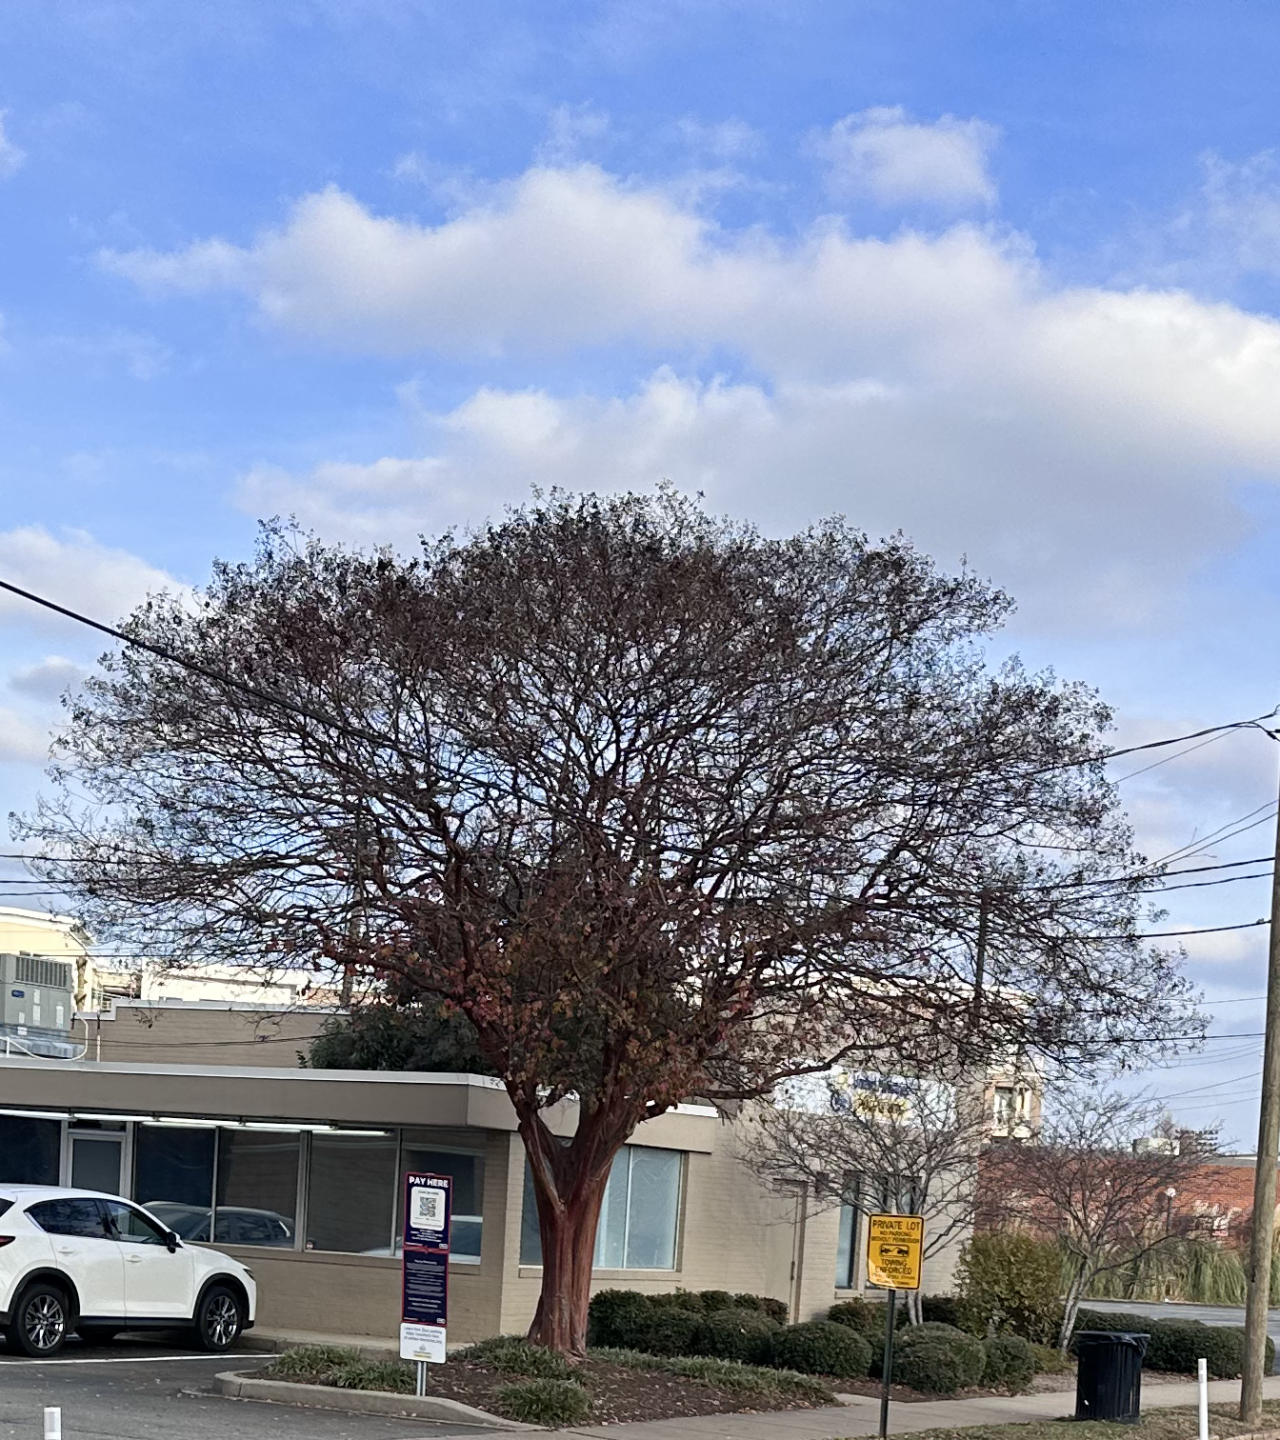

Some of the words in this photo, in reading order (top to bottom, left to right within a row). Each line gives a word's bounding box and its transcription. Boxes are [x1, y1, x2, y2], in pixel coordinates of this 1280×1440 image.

[409, 1176, 426, 1185] PAY
[427, 1178, 449, 1188] HERE
[873, 1220, 903, 1230] PRIVATE
[906, 1221, 920, 1231] LOT
